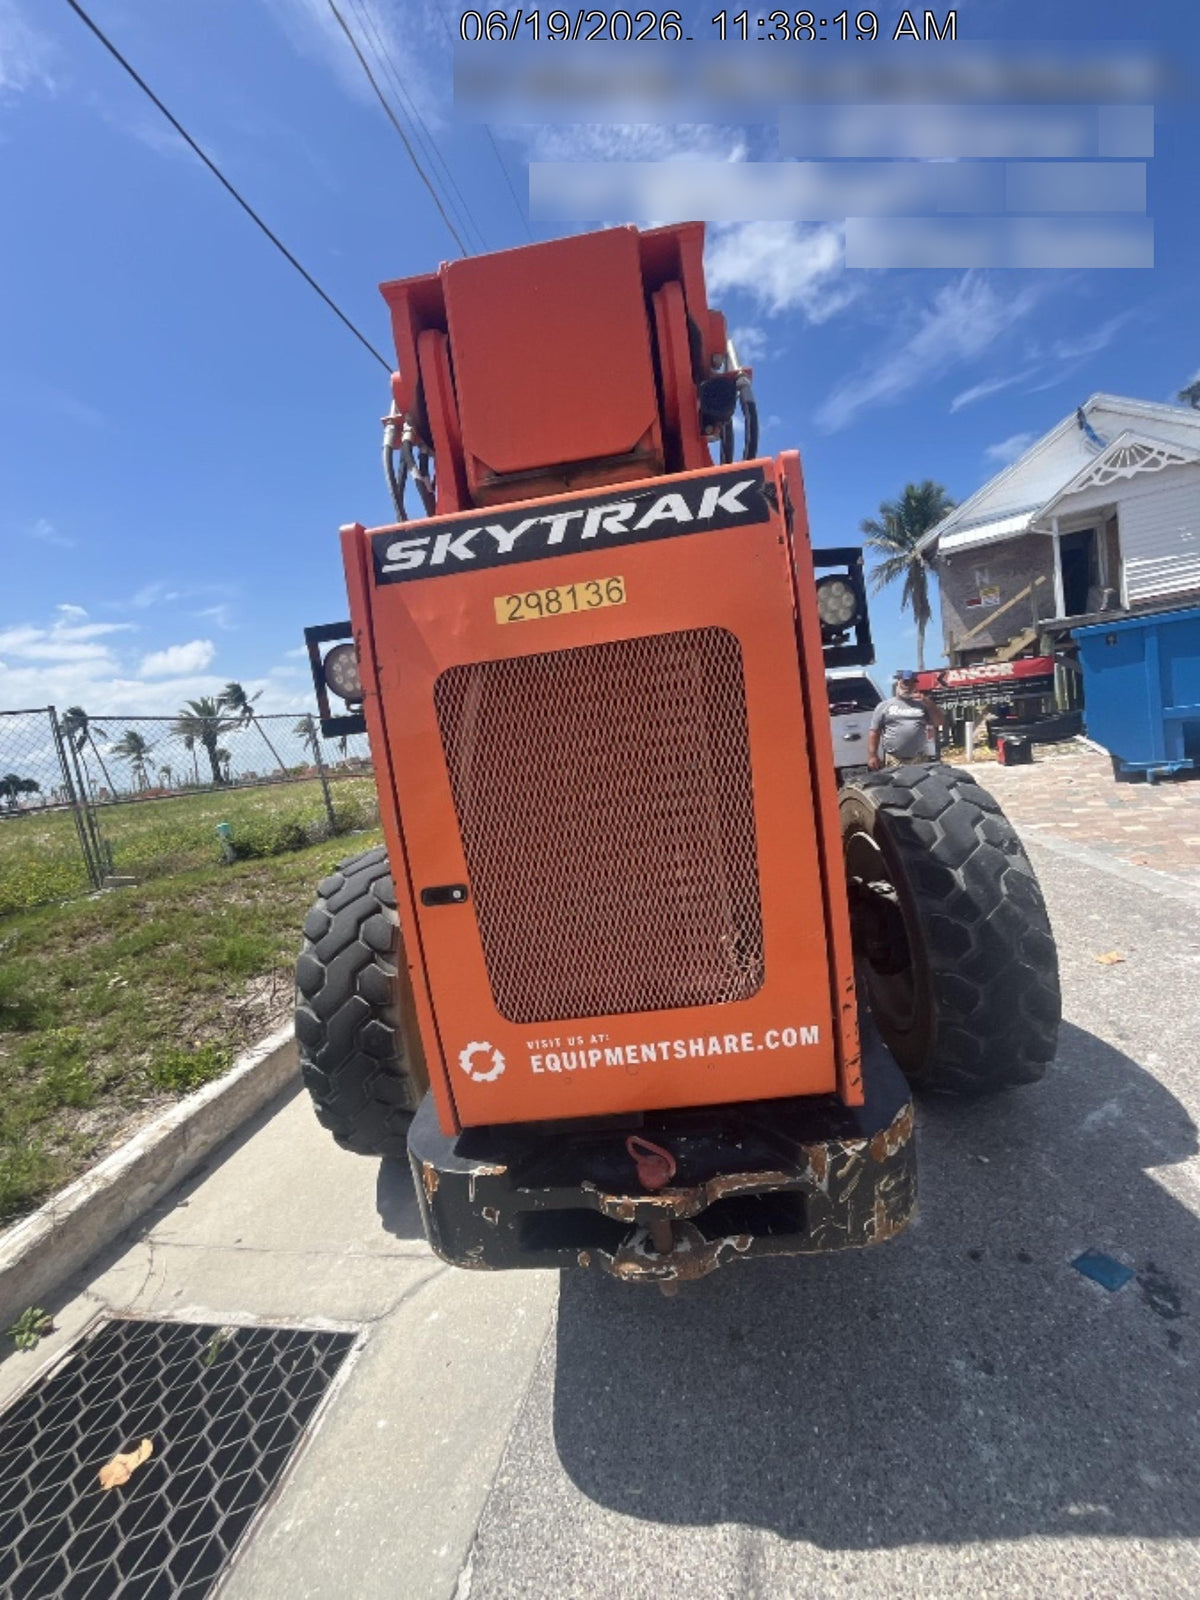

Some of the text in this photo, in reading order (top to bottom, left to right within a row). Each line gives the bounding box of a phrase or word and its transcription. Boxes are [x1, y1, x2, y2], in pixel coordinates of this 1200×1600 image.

[381, 479, 757, 573] SKYTRAK
[506, 577, 625, 621] 298136
[526, 1034, 609, 1050] VISIT US AT:
[530, 1025, 820, 1073] EQUIPMENTSHARE.COM
